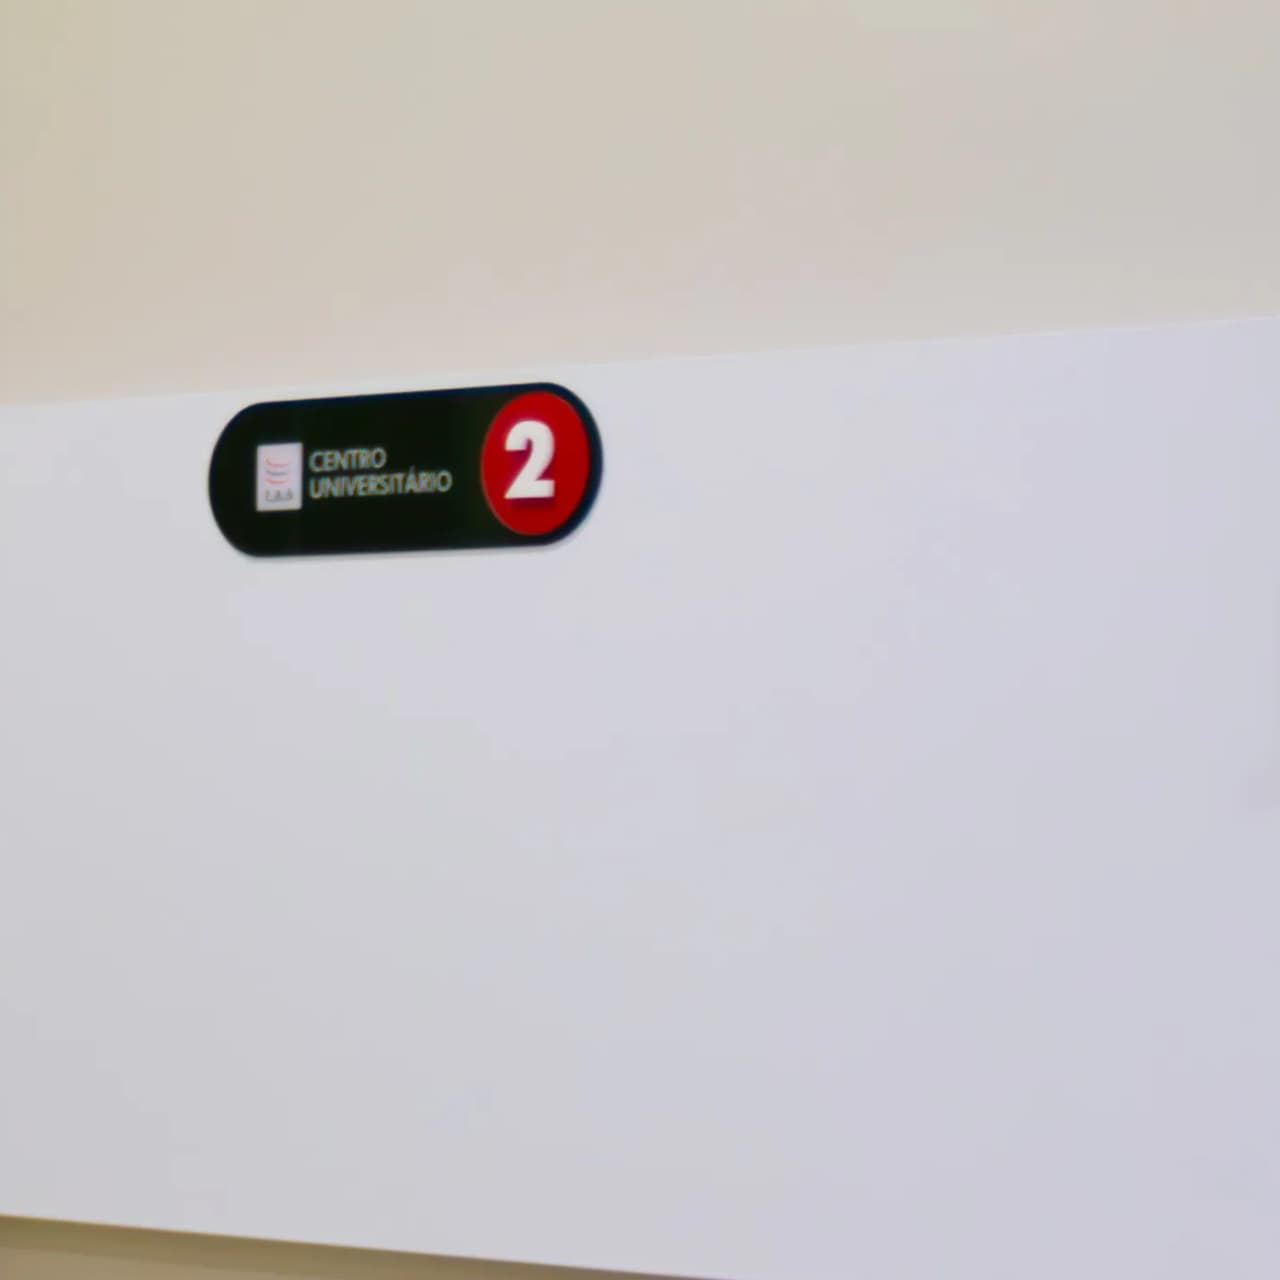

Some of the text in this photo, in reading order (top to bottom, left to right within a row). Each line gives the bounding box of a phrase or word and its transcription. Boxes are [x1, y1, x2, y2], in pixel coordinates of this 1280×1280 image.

[308, 446, 387, 473] CENTRO
[504, 419, 556, 500] 2
[309, 465, 453, 499] UNIVERSITÁRIO
